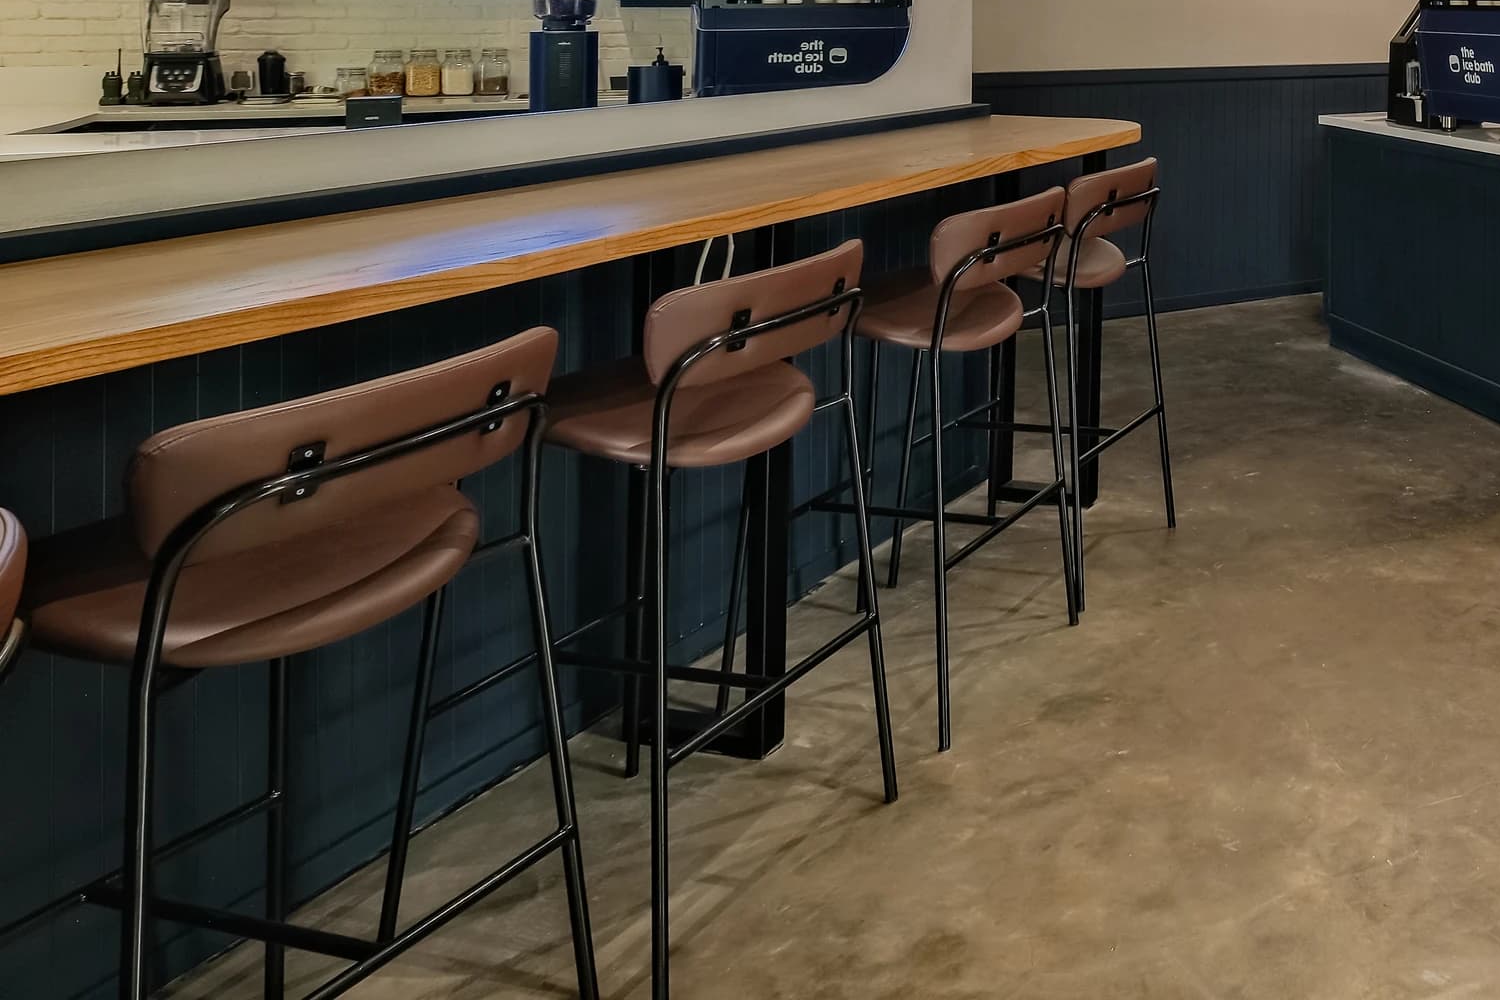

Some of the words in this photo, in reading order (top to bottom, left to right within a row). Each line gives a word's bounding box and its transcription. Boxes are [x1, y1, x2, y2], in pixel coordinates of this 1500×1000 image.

[1461, 46, 1474, 58] the
[1462, 59, 1473, 70] ice
[1474, 60, 1494, 72] bath
[1465, 72, 1480, 84] club
